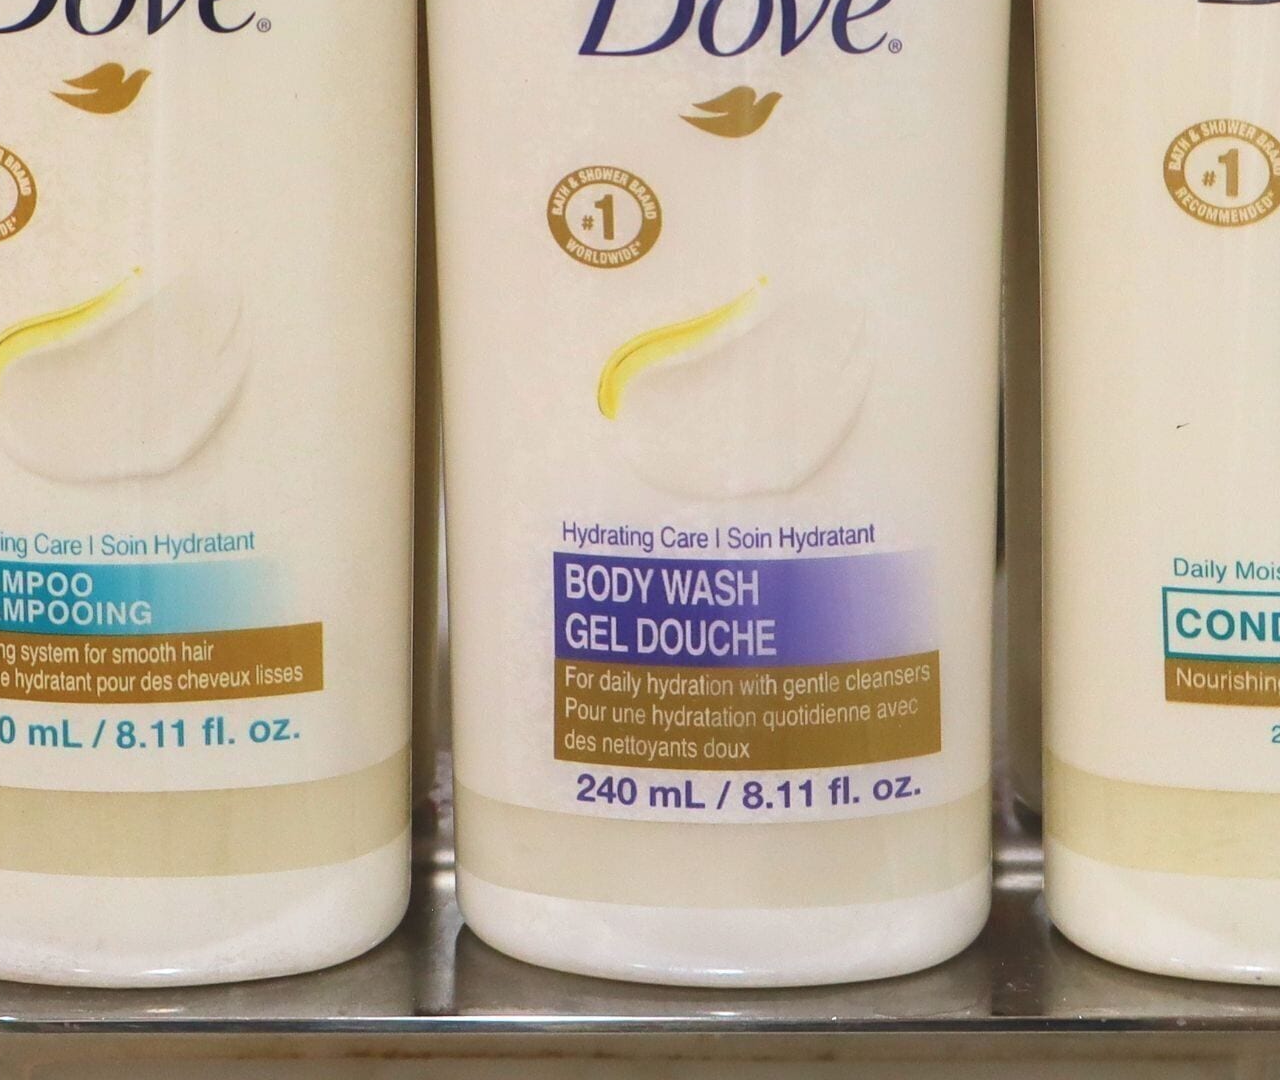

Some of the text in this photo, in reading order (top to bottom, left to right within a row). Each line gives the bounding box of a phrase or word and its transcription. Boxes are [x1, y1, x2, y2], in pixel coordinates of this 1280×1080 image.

[1200, 120, 1257, 139] SHOWER
[4, 155, 32, 197] BRAND
[1202, 148, 1239, 197] #1
[552, 185, 571, 216] BATH
[578, 167, 629, 186] SHOWER
[628, 179, 657, 220] BRAND
[581, 194, 614, 240] #1
[34, 533, 82, 555] Care
[101, 534, 147, 555] Soin
[154, 530, 255, 559] Hydratant
[562, 521, 654, 552] Hydrating
[660, 528, 708, 549] Care
[727, 528, 772, 549] Soin
[779, 523, 875, 552] Hydratant
[565, 563, 760, 606] BODY WASH
[1173, 558, 1227, 582] Daily
[20, 641, 79, 666] system
[84, 642, 107, 664] for
[112, 641, 176, 665] smooth
[181, 639, 213, 660] hair
[565, 613, 777, 656] GEL DOUCHE
[14, 669, 92, 695] hydratant
[96, 671, 134, 697] pour
[140, 669, 173, 691] des
[177, 665, 251, 690] cheveux
[255, 663, 303, 685] lisses
[565, 663, 931, 701] For daily hydration with gentle cleansers
[565, 696, 919, 732] Pour une hydratation quotidienne avec
[28, 719, 83, 749] mL
[116, 719, 185, 750] 8.11
[201, 717, 235, 747] fl.
[249, 718, 300, 744] oz.
[564, 729, 750, 761] des nettoyants doux
[575, 773, 637, 806] 240
[649, 780, 706, 810] mL
[742, 780, 813, 810] 8.11
[828, 776, 860, 804] fl.
[872, 775, 922, 802] oz.
